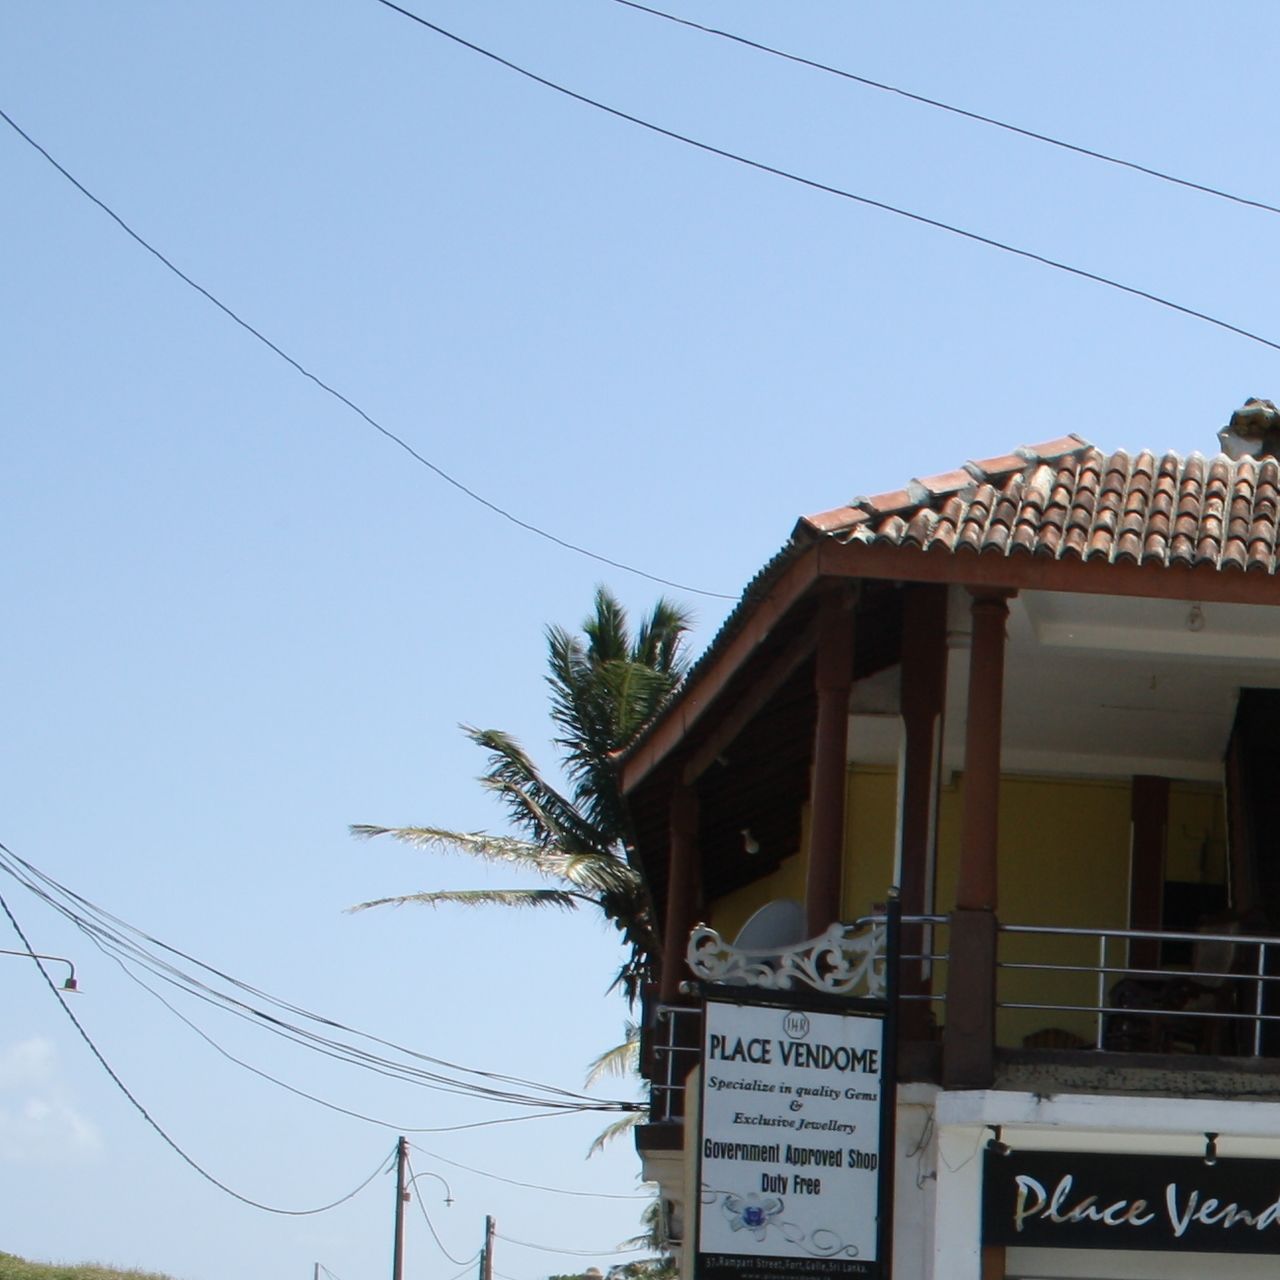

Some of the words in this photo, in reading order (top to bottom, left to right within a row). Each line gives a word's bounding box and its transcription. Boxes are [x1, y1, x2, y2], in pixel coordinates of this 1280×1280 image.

[709, 1034, 772, 1064] PLACE
[778, 1040, 878, 1074] VENDOME
[708, 1075, 775, 1093] Specialize
[779, 1082, 792, 1094] in
[796, 1084, 841, 1100] quality
[845, 1088, 878, 1101] Gems
[733, 1112, 795, 1128] Exclusive
[796, 1118, 856, 1135] Jewellery
[704, 1138, 780, 1163] Government
[785, 1144, 842, 1168] Approved
[848, 1148, 878, 1172] Shop
[762, 1172, 788, 1195] Duty
[794, 1174, 821, 1195] Free
[1014, 1175, 1155, 1232] Place
